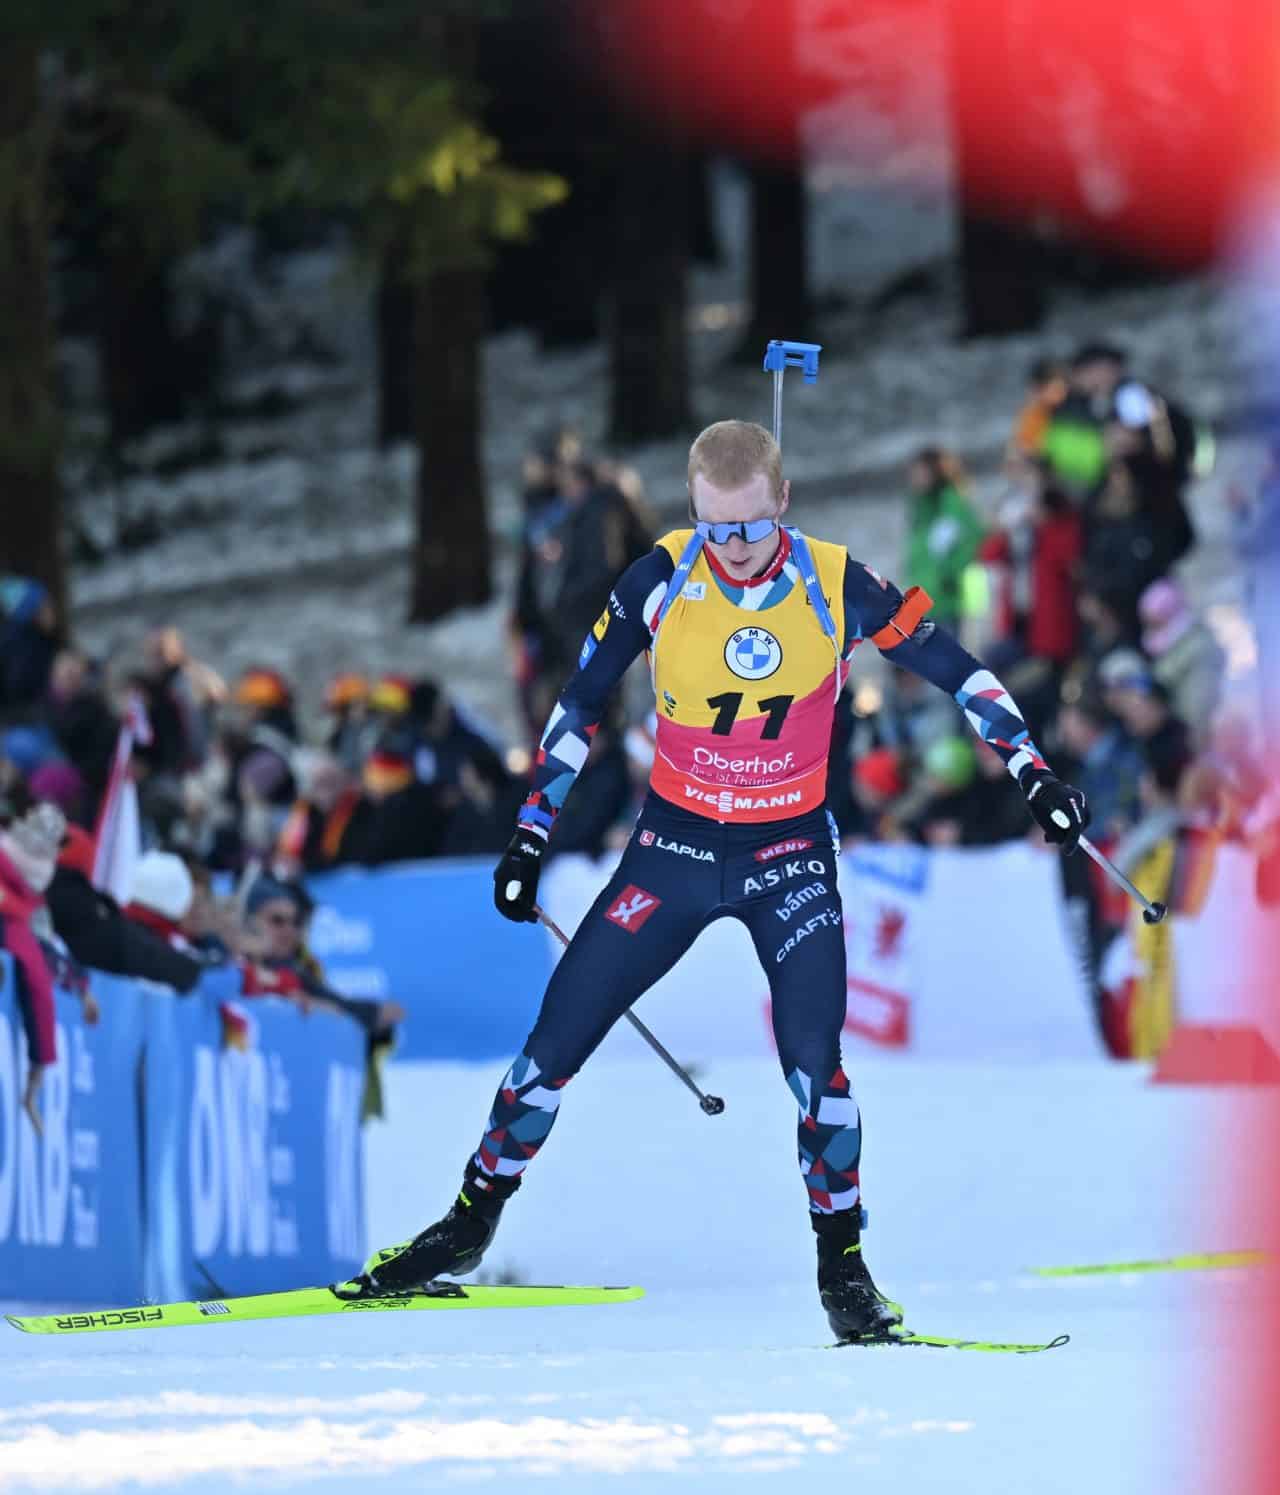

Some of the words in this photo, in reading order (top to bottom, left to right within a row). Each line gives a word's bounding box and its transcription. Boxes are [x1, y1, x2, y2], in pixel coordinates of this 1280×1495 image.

[732, 629, 775, 645] BMW
[706, 692, 795, 740] 11
[684, 784, 802, 814] VIESSMANN
[656, 837, 716, 863] LAPUA
[776, 912, 829, 963] CRAFT
[55, 1308, 164, 1329] FISCHER
